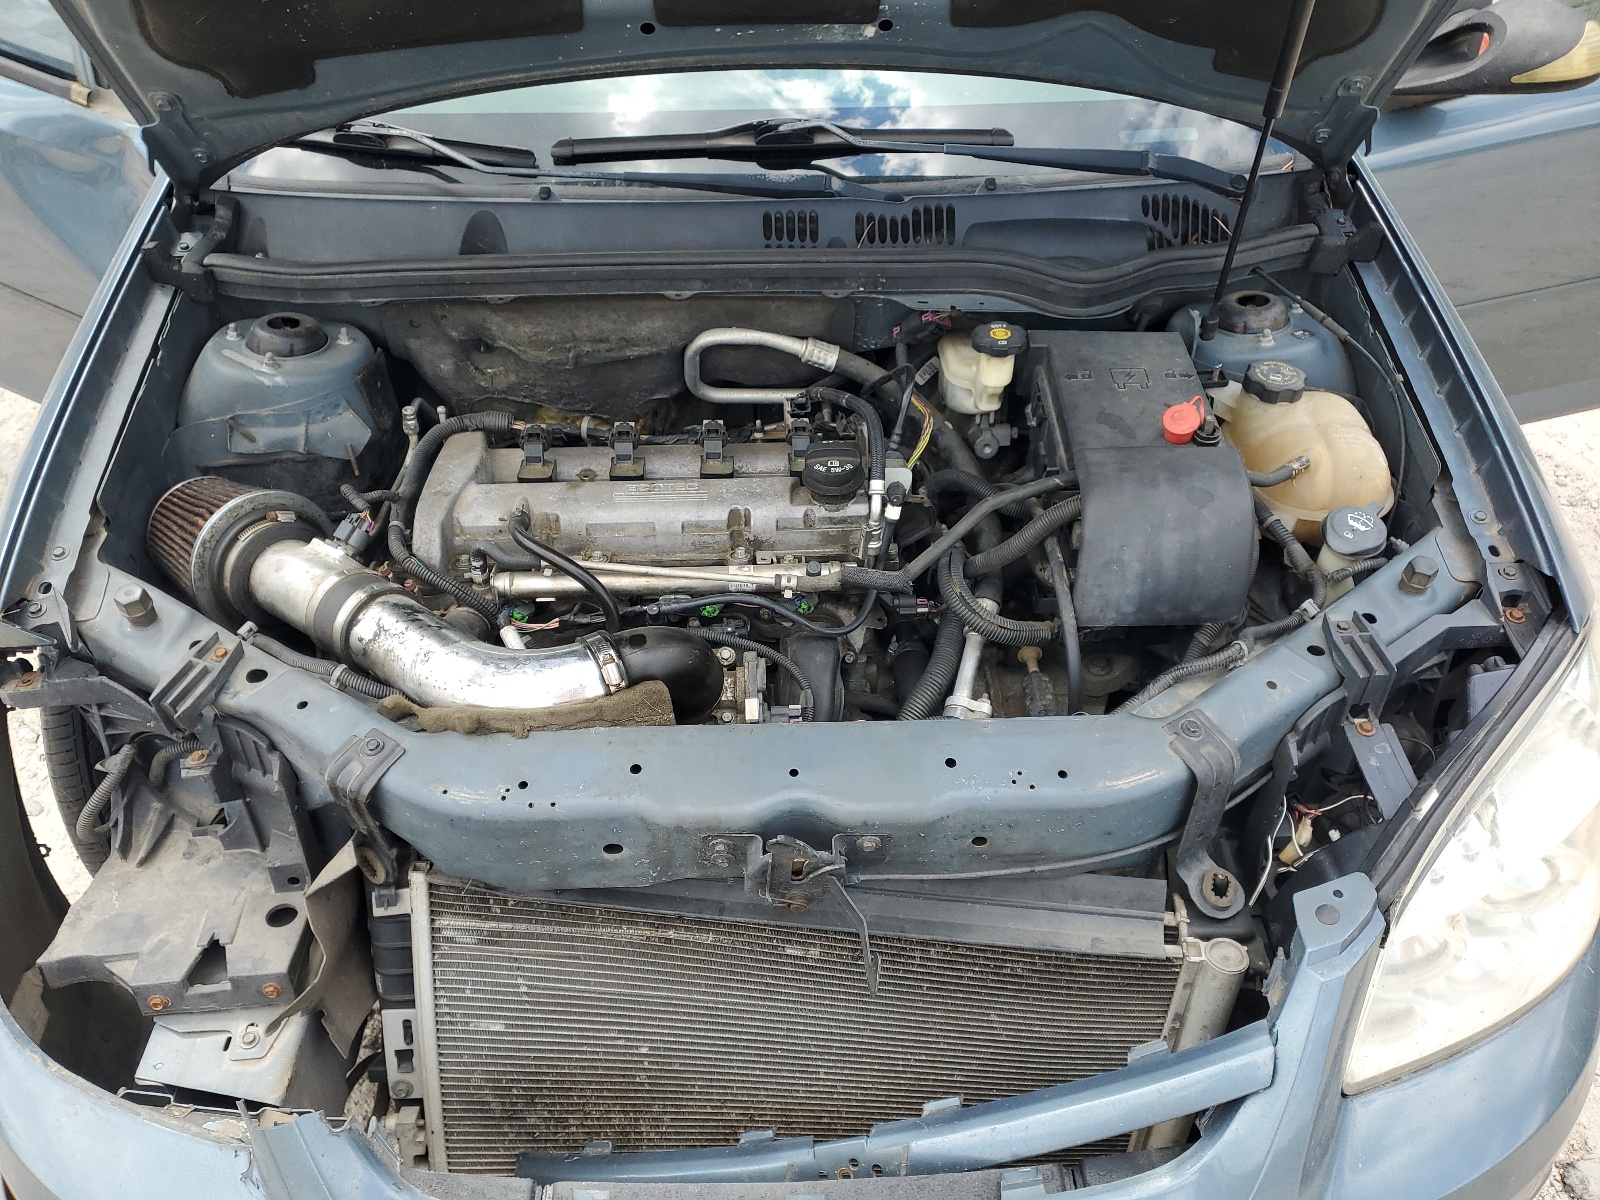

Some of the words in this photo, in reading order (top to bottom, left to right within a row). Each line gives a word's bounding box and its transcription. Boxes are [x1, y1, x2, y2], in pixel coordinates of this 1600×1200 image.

[813, 463, 828, 473] SAE
[830, 463, 854, 473] 5W-30
[625, 482, 699, 492] ECOTEC
